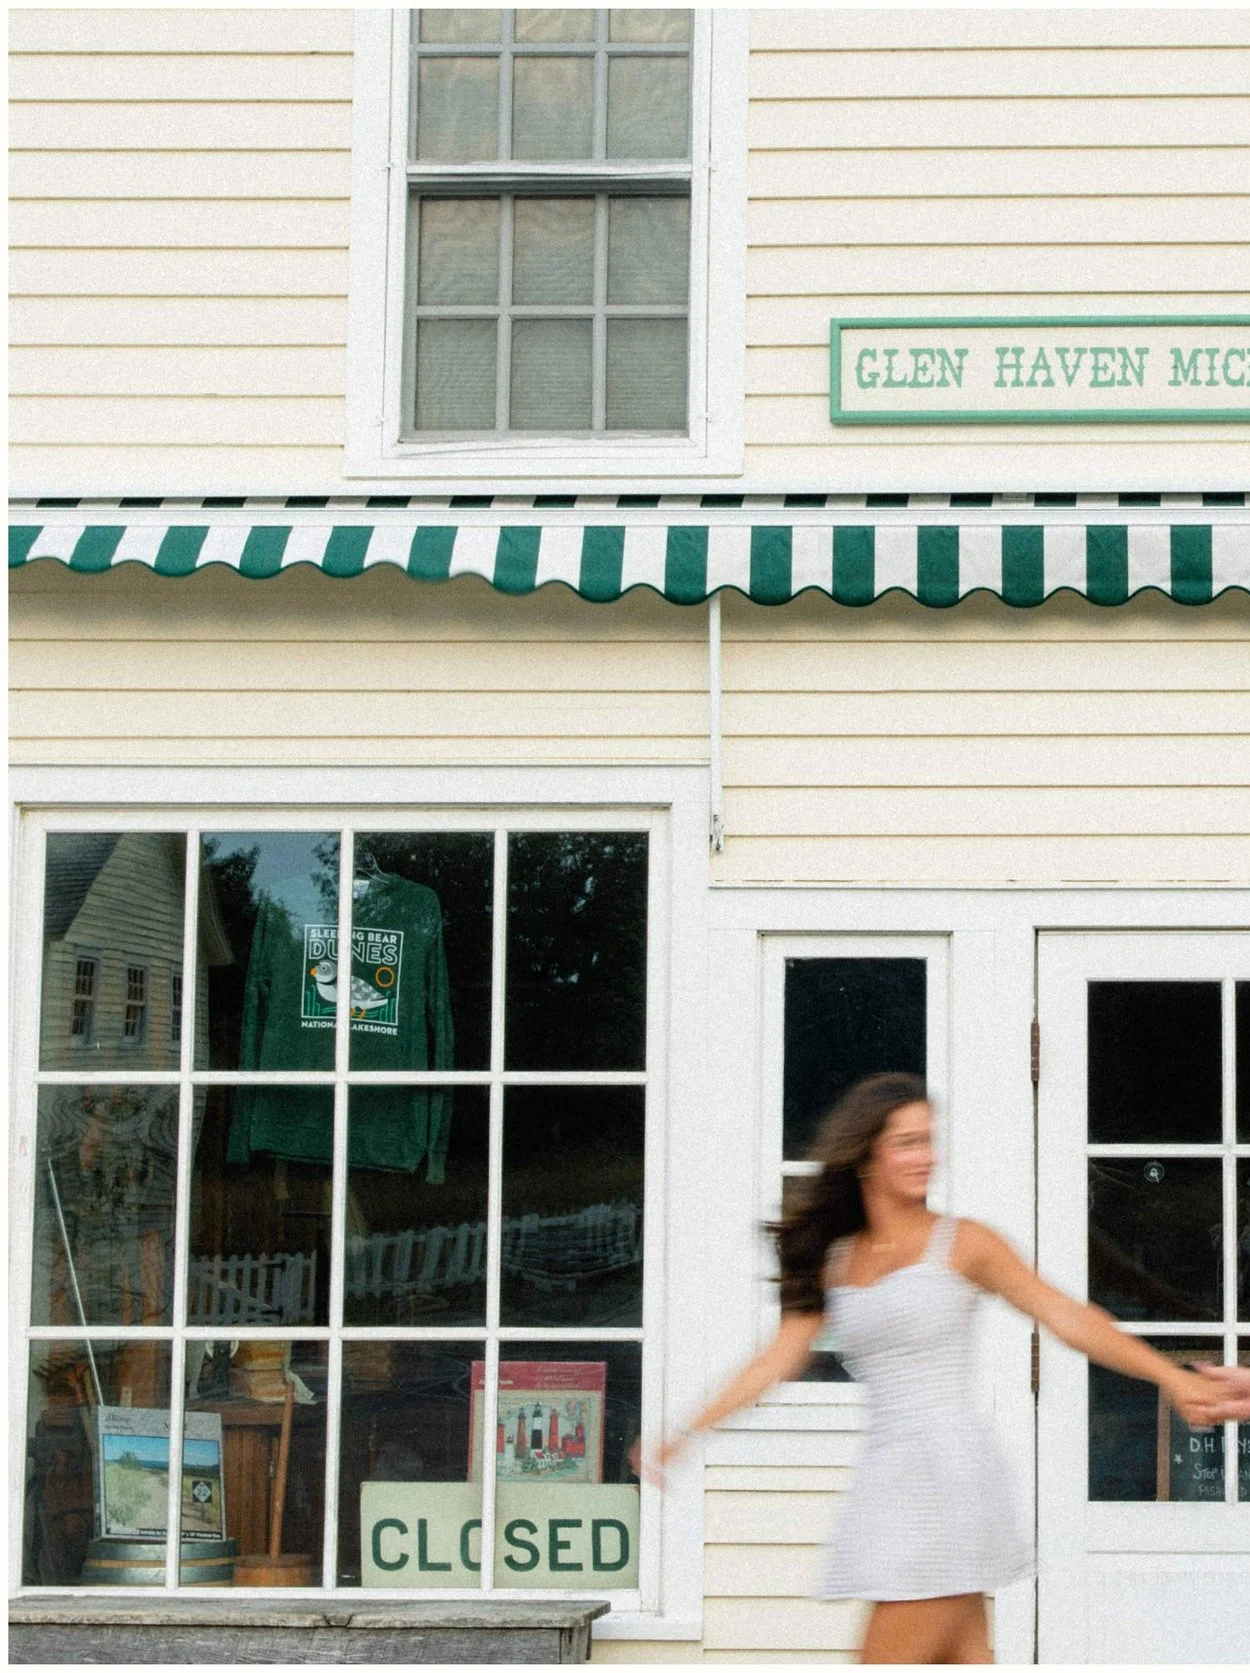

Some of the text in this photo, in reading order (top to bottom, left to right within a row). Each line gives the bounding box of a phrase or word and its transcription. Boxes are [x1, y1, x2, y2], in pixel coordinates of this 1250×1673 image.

[855, 348, 969, 389] GLEN
[994, 347, 1150, 388] HAVEN
[310, 929, 398, 944] SLEEG BEAR
[308, 939, 398, 965] DUNES
[301, 1021, 398, 1036] NATION AKESHORE
